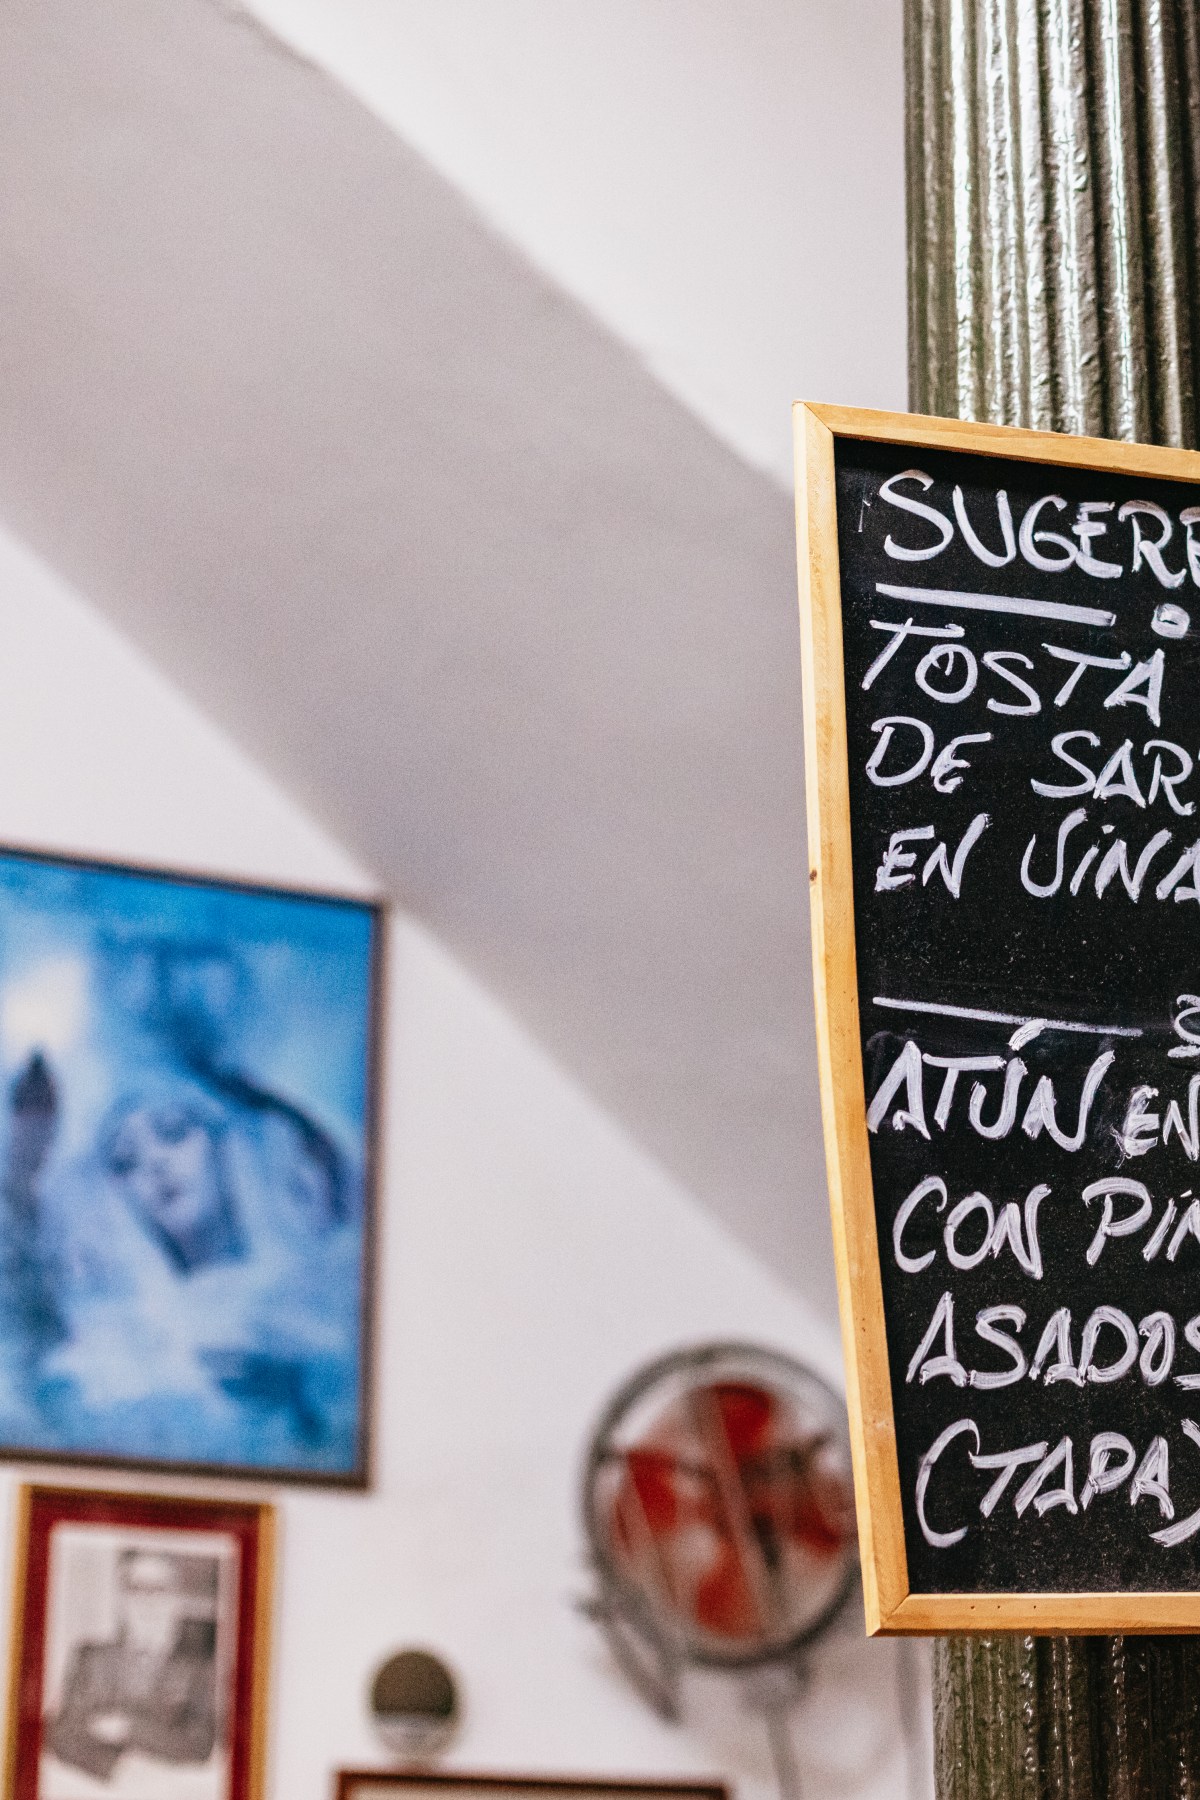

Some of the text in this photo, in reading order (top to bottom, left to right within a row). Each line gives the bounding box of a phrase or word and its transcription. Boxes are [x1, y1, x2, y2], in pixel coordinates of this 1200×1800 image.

[862, 616, 1166, 728] TOSTA
[865, 714, 993, 794] DE
[874, 812, 990, 899] EN
[866, 1018, 1117, 1152] ATÚN
[892, 1175, 1053, 1281] CON
